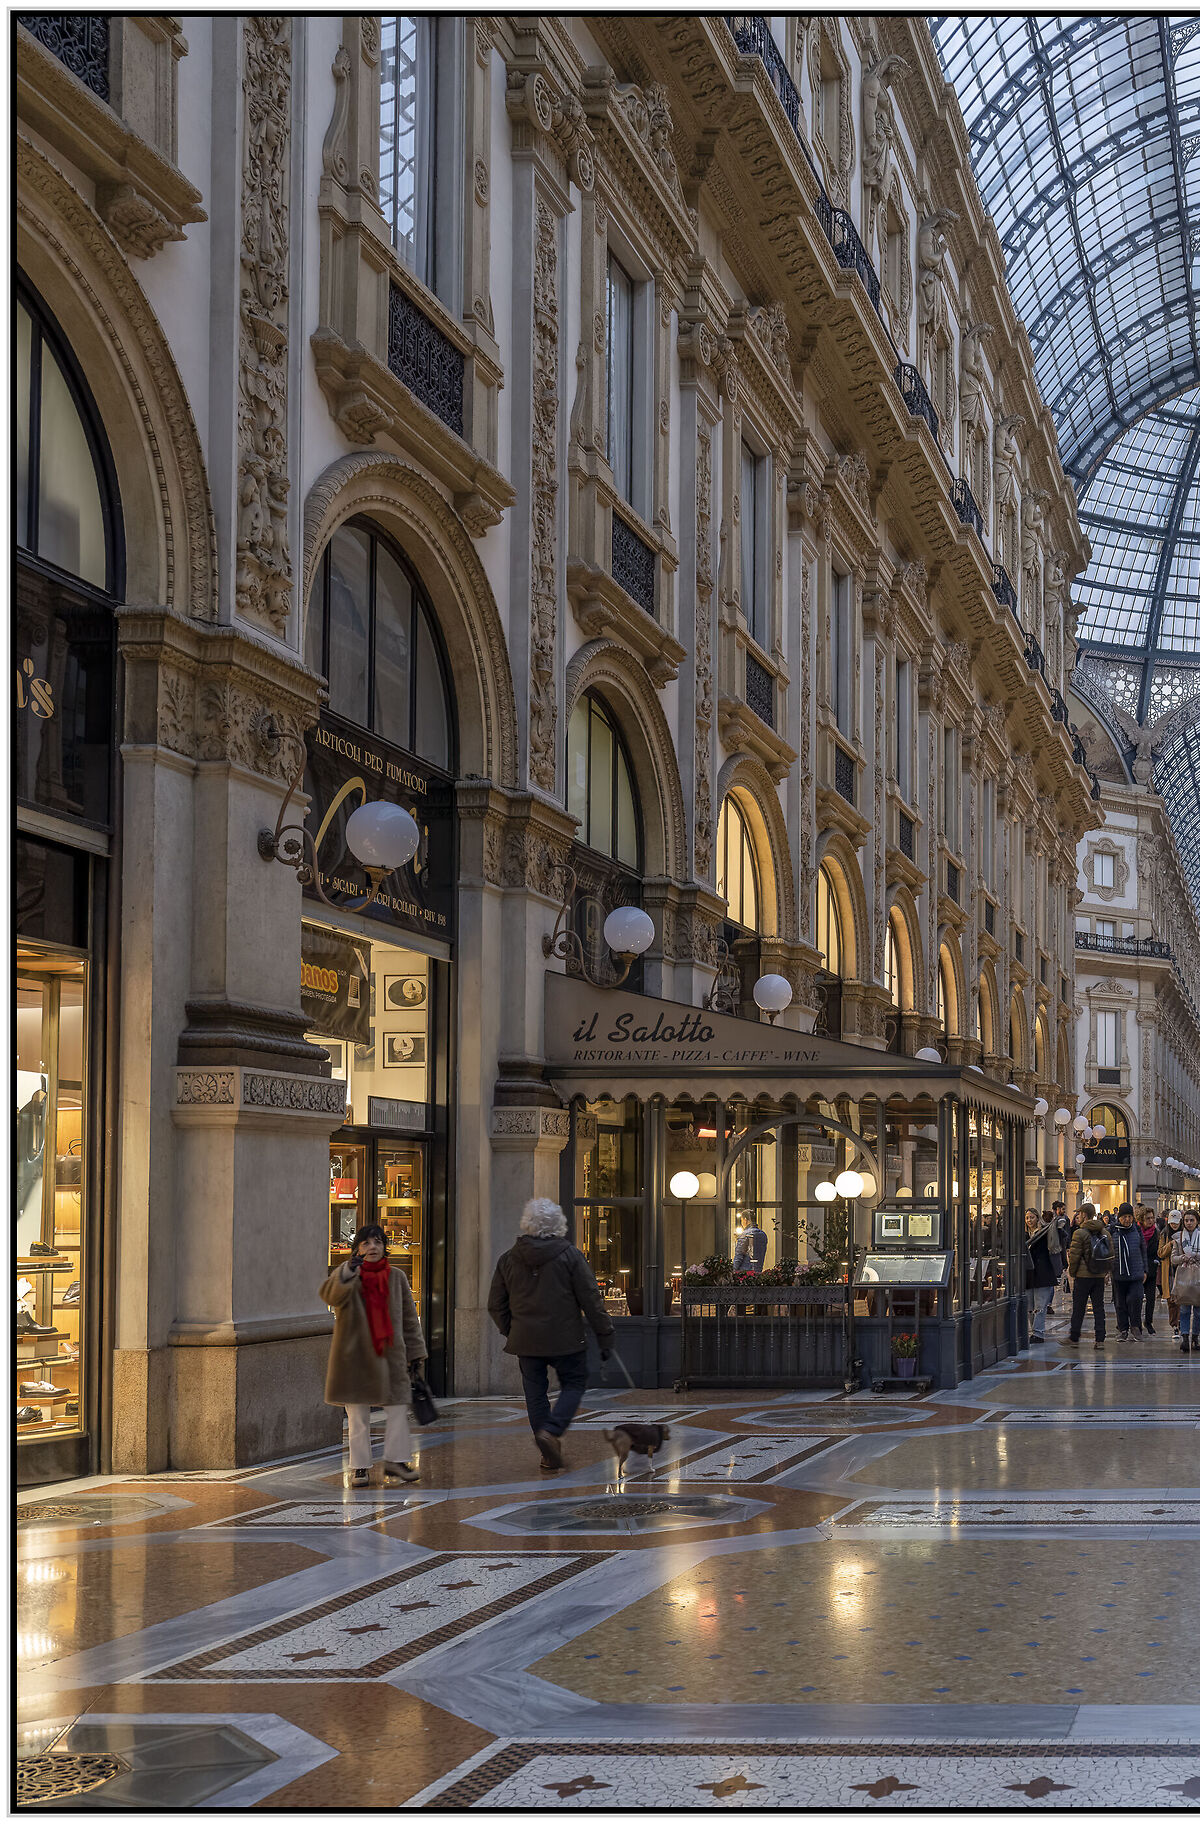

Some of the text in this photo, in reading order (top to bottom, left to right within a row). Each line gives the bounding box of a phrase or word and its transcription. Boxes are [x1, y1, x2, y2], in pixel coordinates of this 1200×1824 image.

[315, 727, 428, 796] ARTICOLI PER FUMATORI
[332, 876, 358, 897] SIGARI
[392, 897, 417, 917] BOLLATI
[573, 1012, 716, 1043] il Salotto
[573, 1050, 660, 1061] RISTORANTE
[672, 1050, 712, 1061] PIZZA
[783, 1050, 820, 1061] WINE
